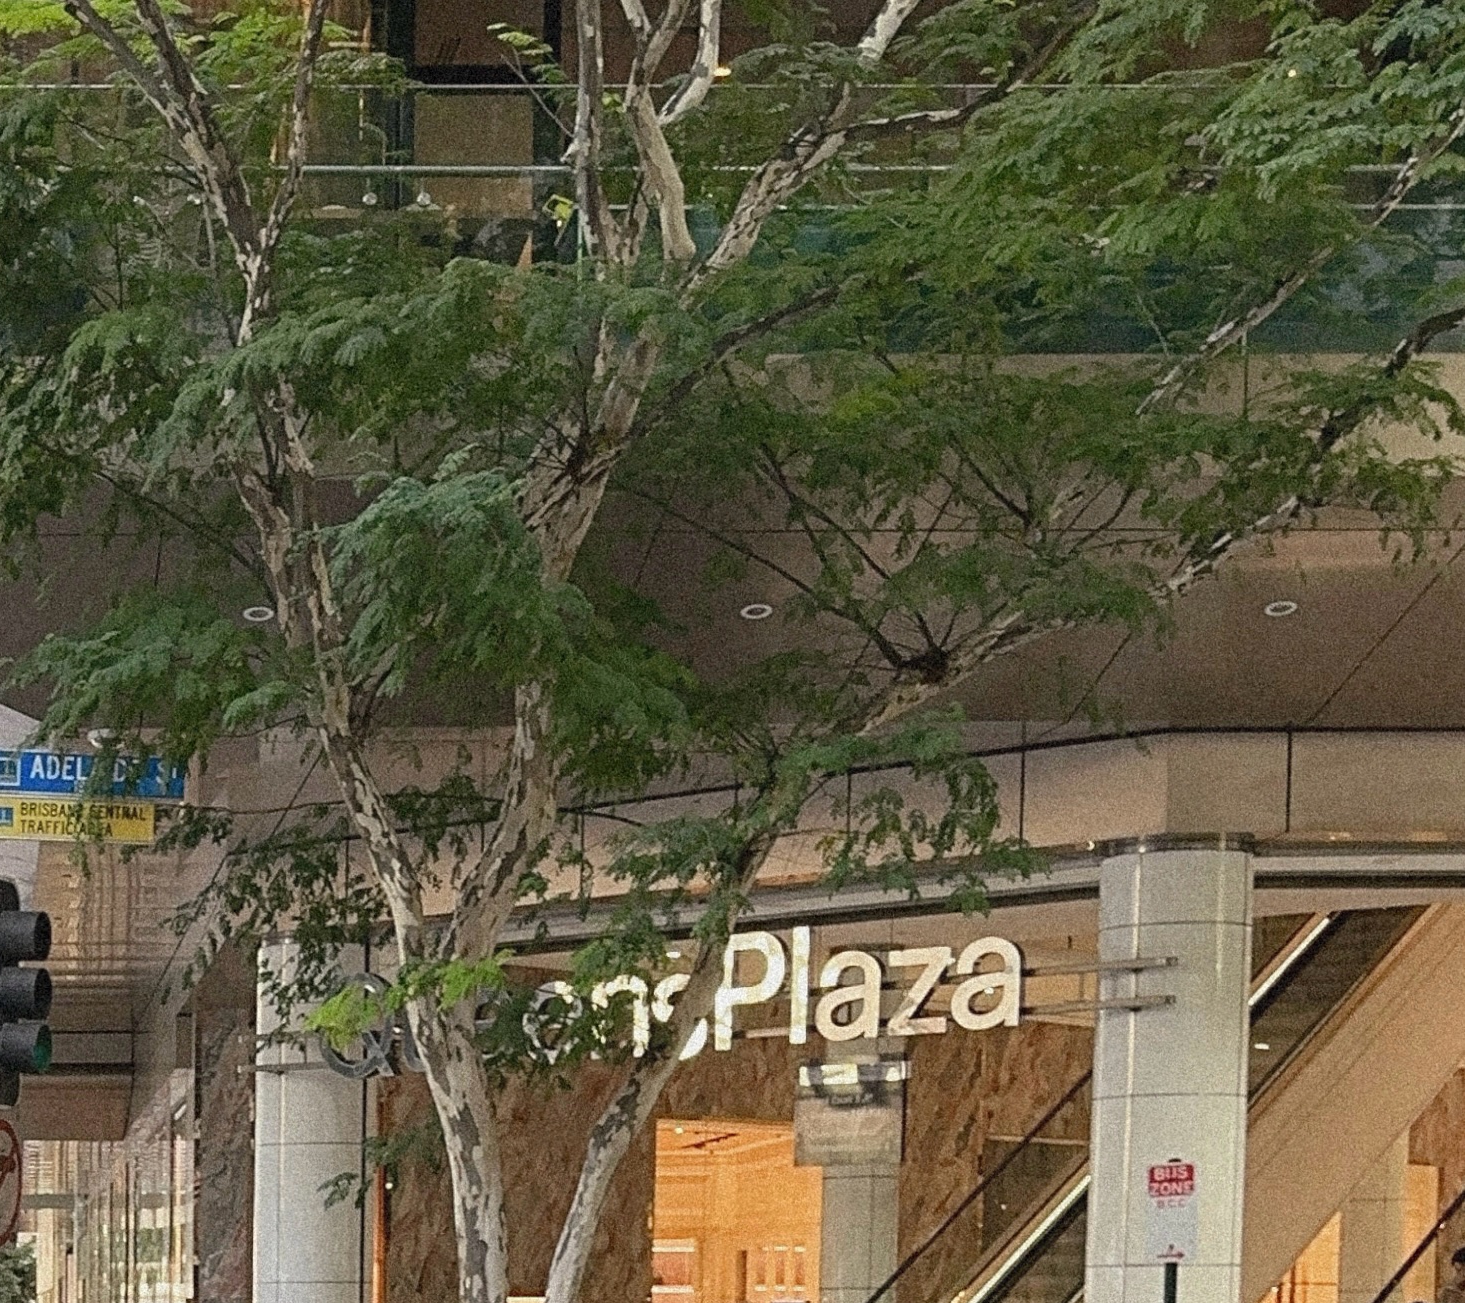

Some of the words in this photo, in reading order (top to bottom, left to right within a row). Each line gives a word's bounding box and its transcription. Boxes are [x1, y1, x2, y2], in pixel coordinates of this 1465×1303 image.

[30, 754, 141, 784] ADELD
[715, 926, 1022, 1051] Plaza
[1153, 1166, 1188, 1181] BUS
[1149, 1181, 1193, 1196] ZONE
